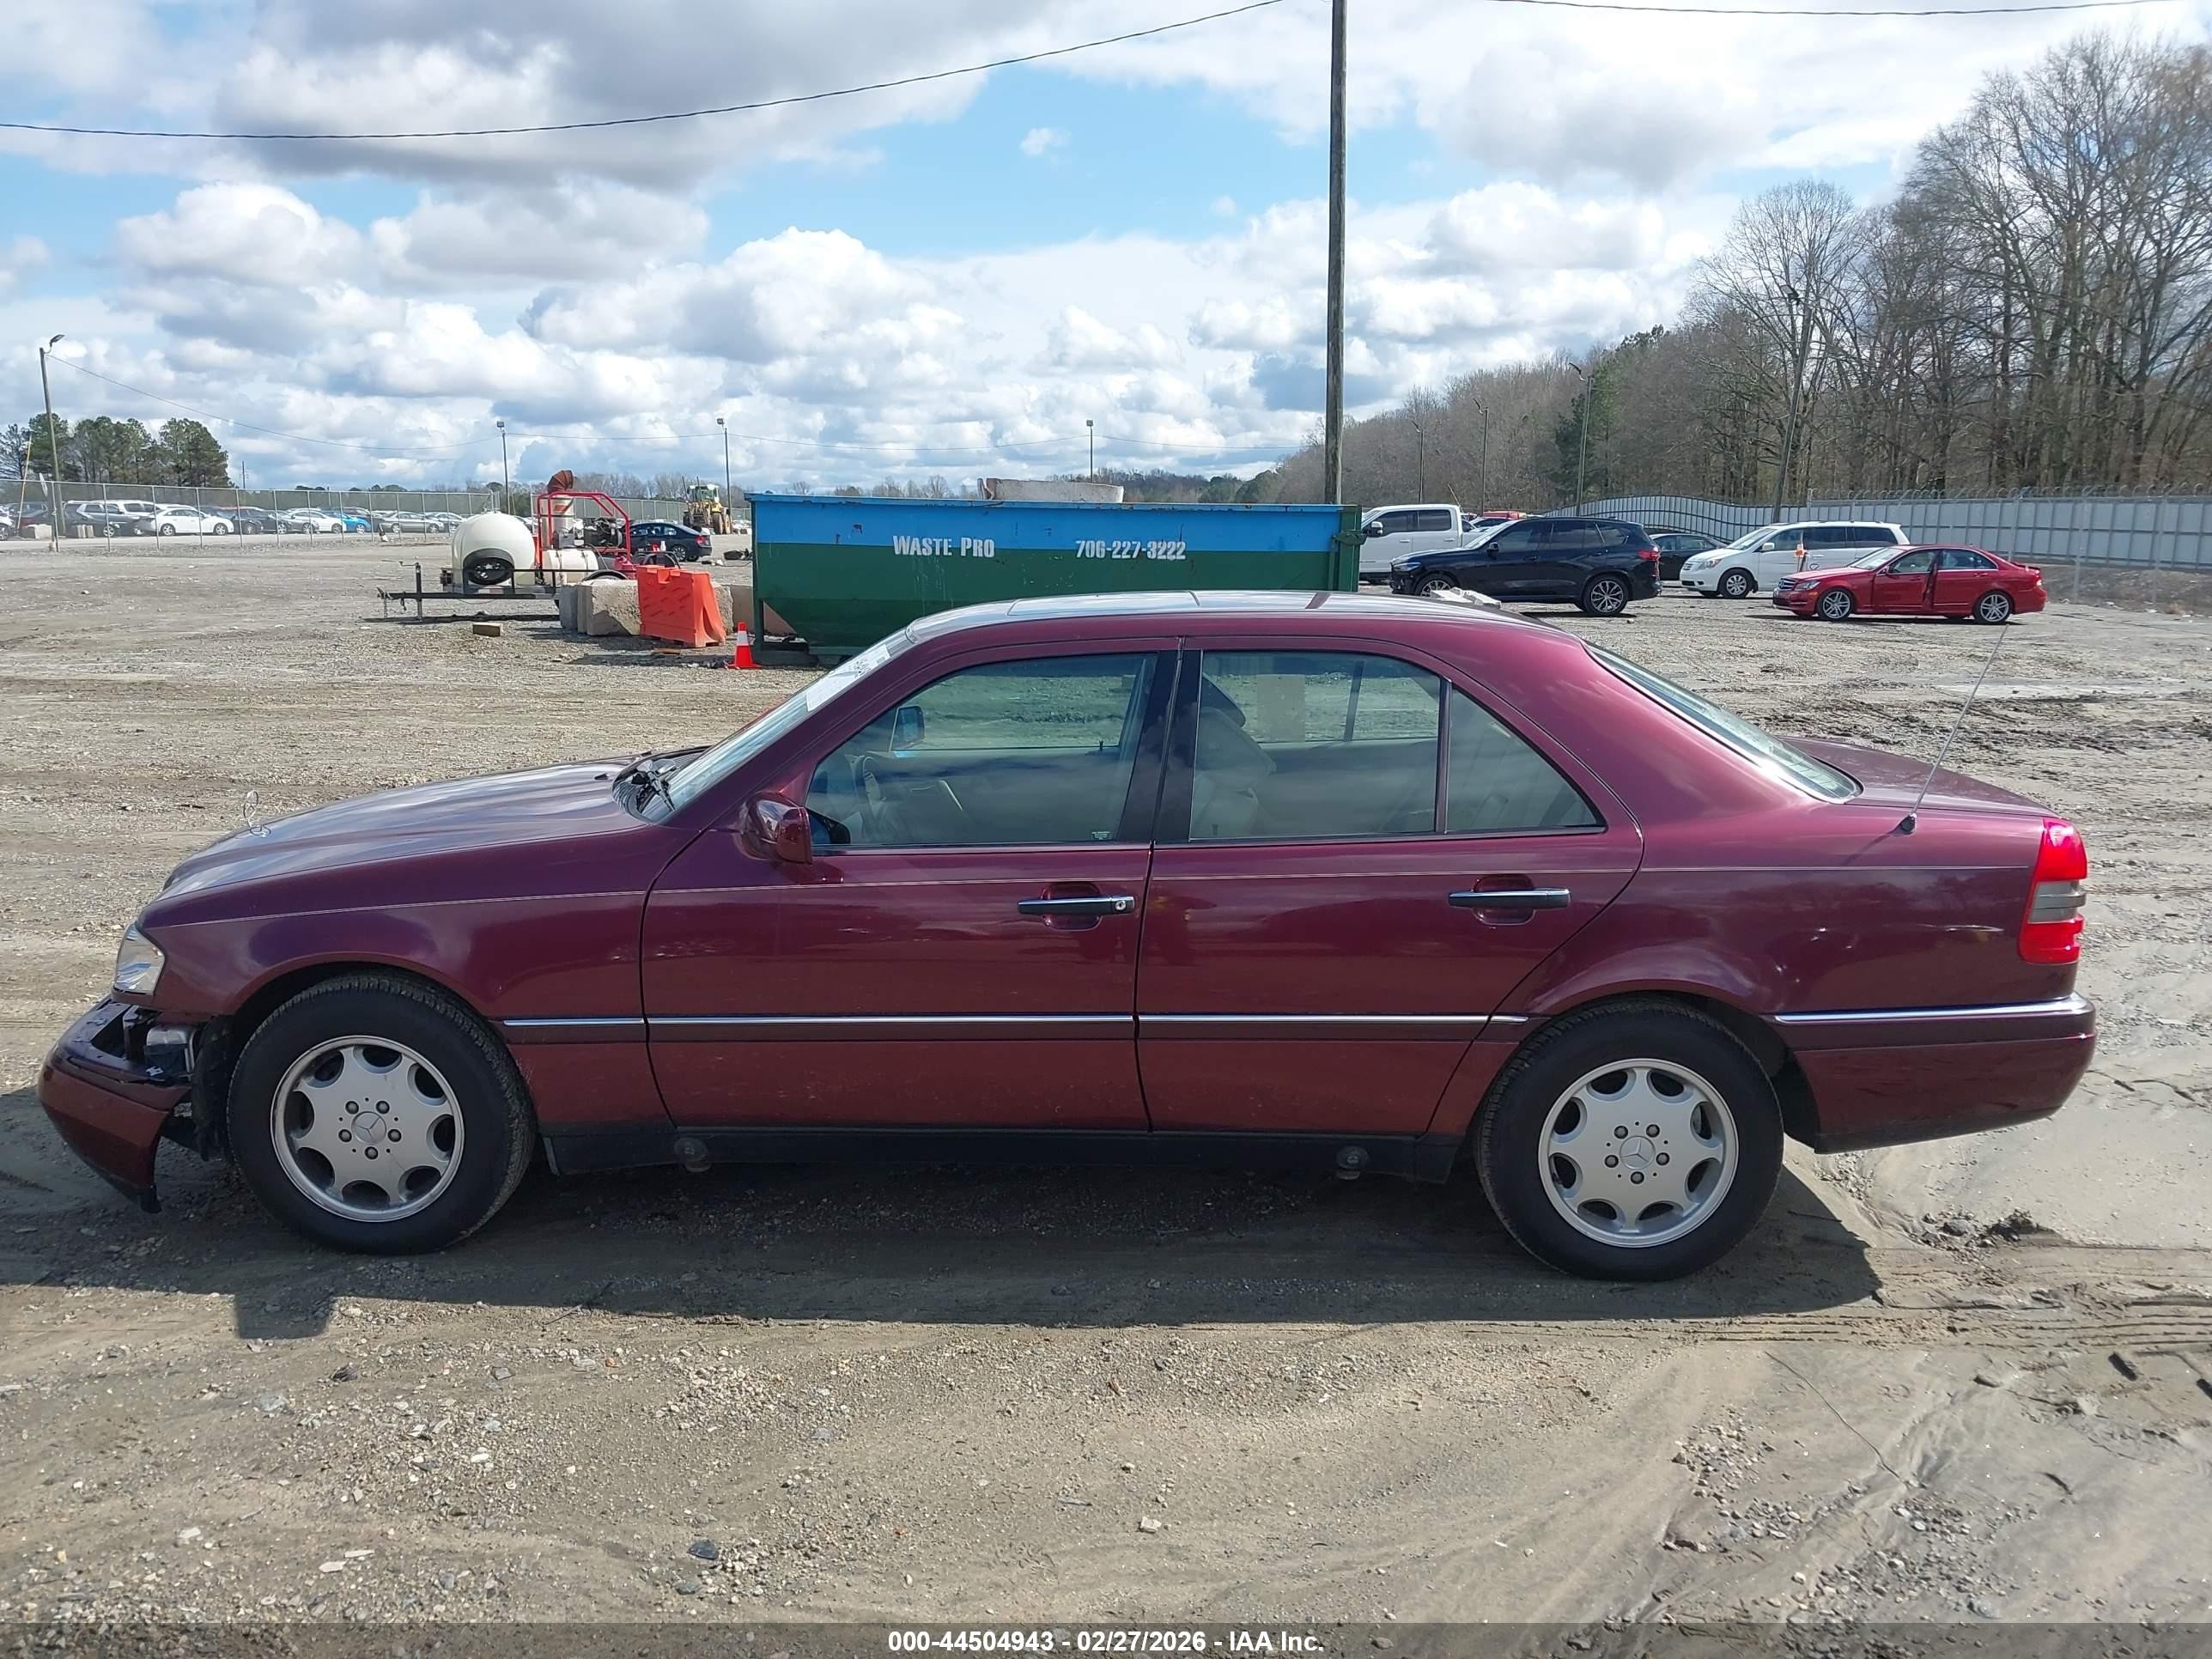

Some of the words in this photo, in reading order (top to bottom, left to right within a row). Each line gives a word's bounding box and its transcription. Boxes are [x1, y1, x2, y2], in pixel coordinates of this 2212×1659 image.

[892, 535, 953, 556] WASTE
[960, 537, 996, 558] PRO
[1075, 539, 1186, 561] 706-227-3222
